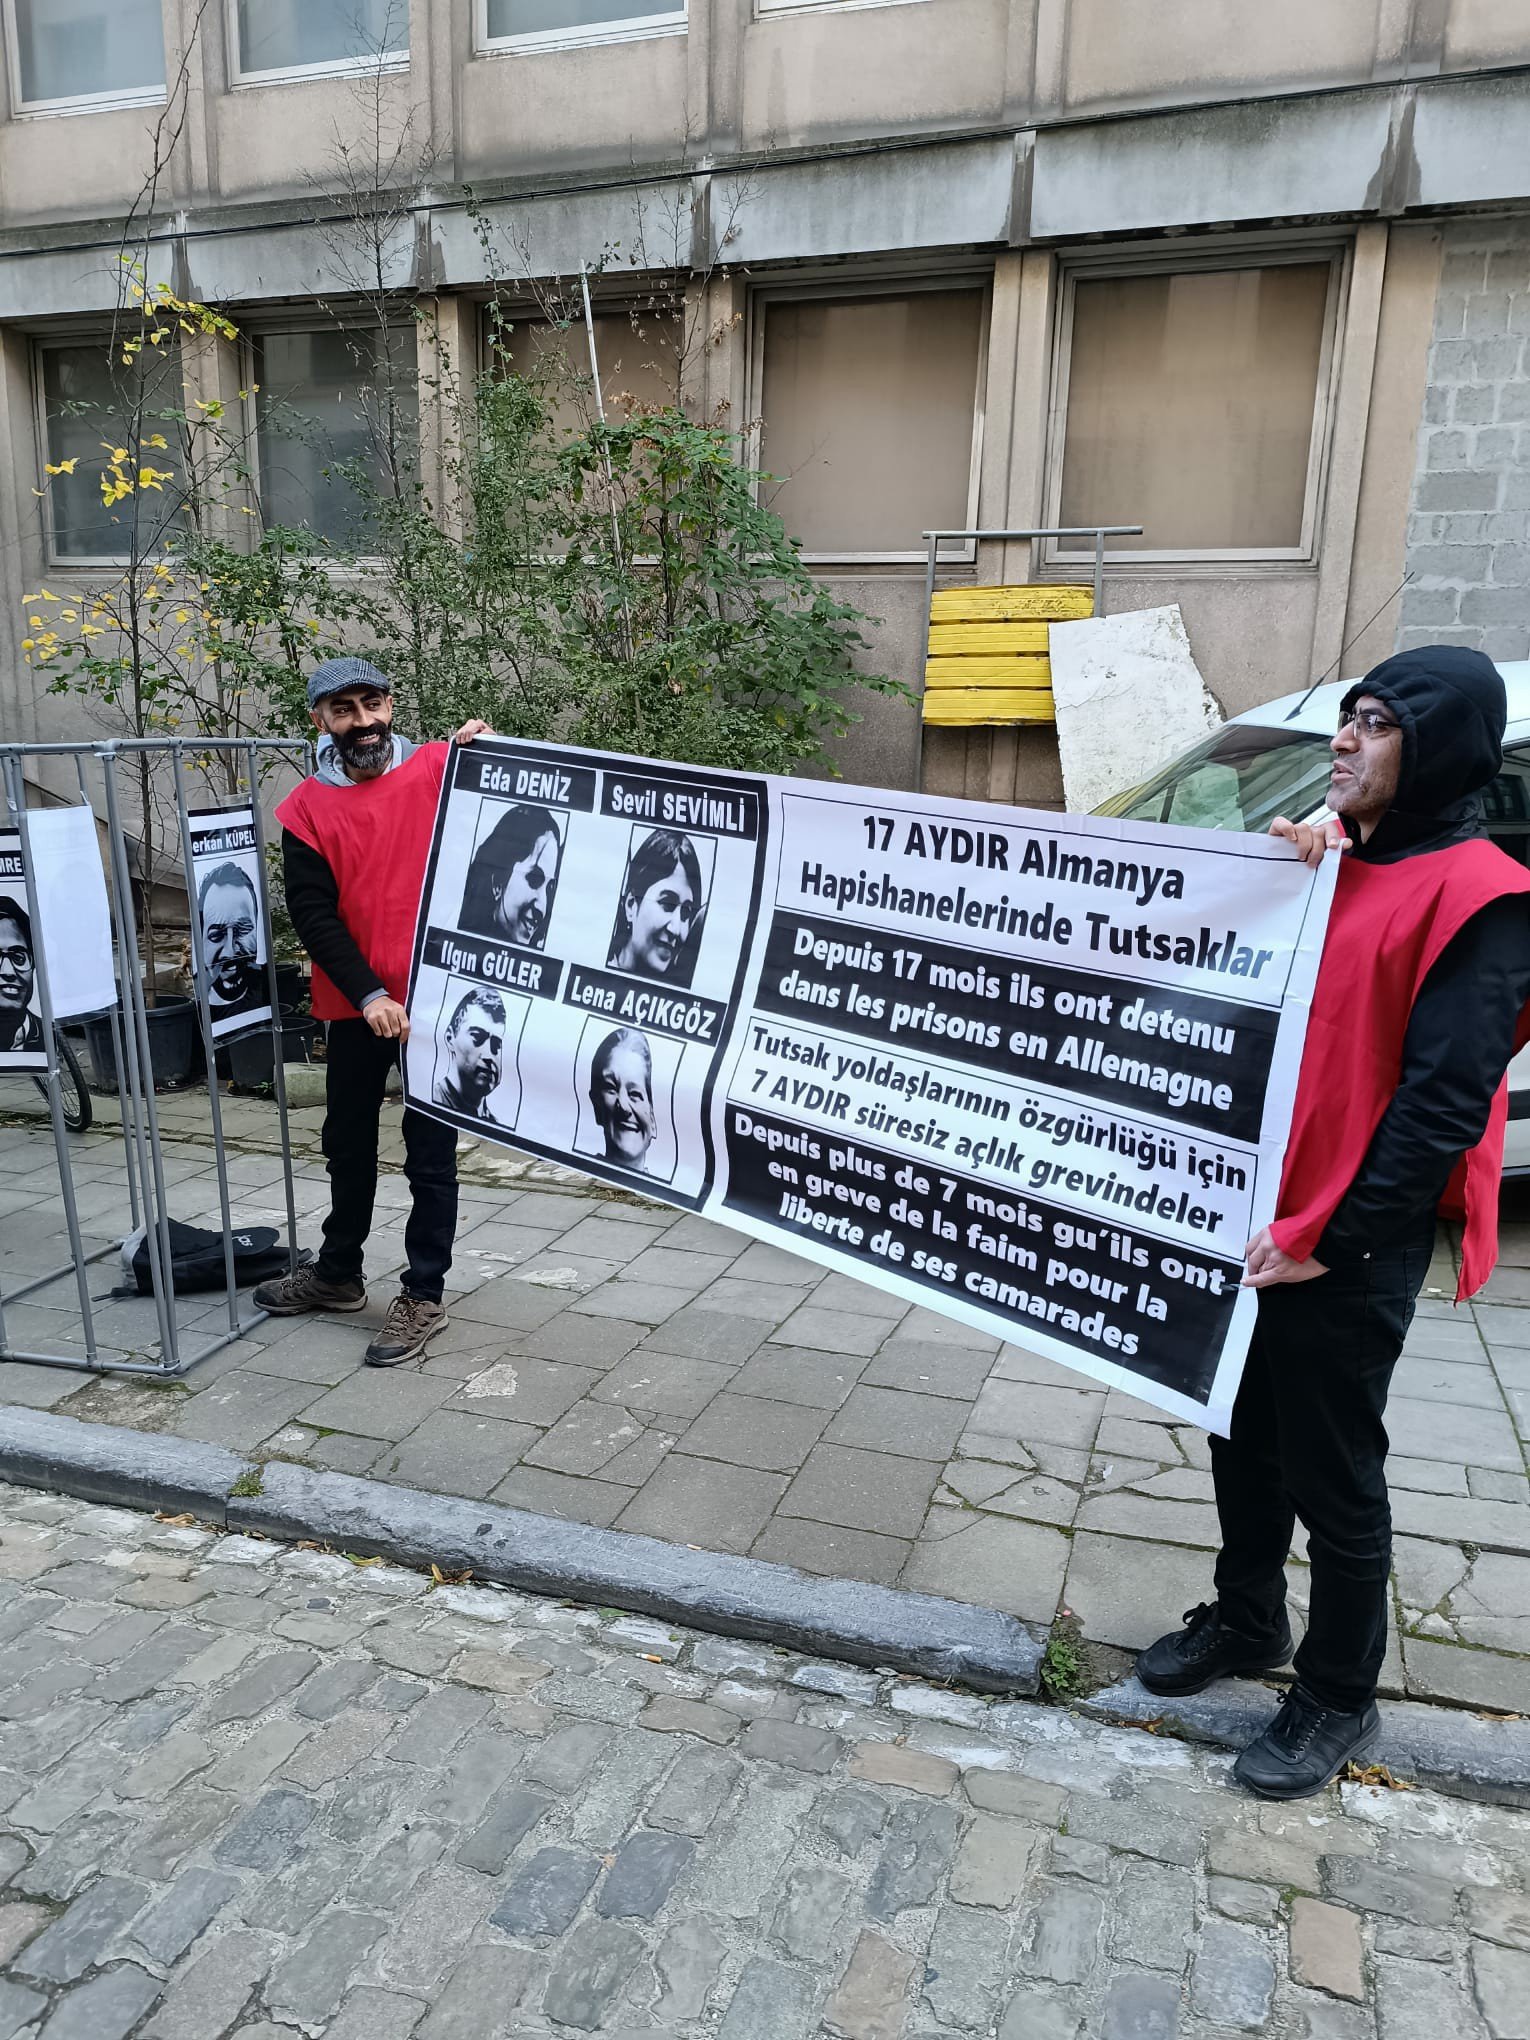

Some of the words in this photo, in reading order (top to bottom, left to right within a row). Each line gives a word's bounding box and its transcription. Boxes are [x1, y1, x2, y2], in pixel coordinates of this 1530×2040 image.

[479, 763, 510, 793] Eda
[515, 769, 572, 802] DENİZ
[612, 784, 657, 817] Sevil
[662, 791, 745, 832] SEVİMLİ
[192, 836, 223, 853] erkan
[863, 814, 896, 852] 17
[903, 822, 1008, 872] AYDIR
[1019, 838, 1185, 907] Almanya
[440, 939, 477, 973] Ilgın
[481, 950, 543, 990] GÜLER
[800, 861, 1073, 946] Hapishanelerinde
[1085, 912, 1274, 980] Tutsaklar
[570, 975, 615, 1012] Lena
[619, 990, 717, 1039] AÇIKGÖZ
[778, 969, 841, 1009] dans
[846, 983, 886, 1020] les
[889, 1001, 1002, 1049] prisons
[1008, 1030, 1049, 1061] en
[1054, 1035, 1233, 1111] Allemagne
[793, 927, 884, 973] Depuis
[892, 948, 923, 981] 17
[929, 965, 1001, 999] mois
[1009, 972, 1046, 1009] ils
[1053, 991, 1114, 1025] ont
[1119, 997, 1236, 1055] detenu
[750, 1068, 769, 1093] 7
[768, 1074, 852, 1121] AYDIR
[854, 1102, 950, 1150] süresiz
[954, 1135, 1026, 1174] açlık
[1028, 1158, 1224, 1234] grevindeler
[752, 1026, 831, 1070] Tutsak
[831, 1054, 1011, 1122] yoldaşlarının
[1018, 1098, 1177, 1171] özgürlüğü
[1187, 1145, 1246, 1191] için
[734, 1111, 822, 1160] Depuis
[828, 1146, 887, 1182] plus
[894, 1165, 931, 1195] de
[938, 1177, 959, 1204] 7
[966, 1191, 1044, 1232] mois
[1160, 1256, 1226, 1296] ont
[767, 1161, 799, 1185] en
[805, 1173, 882, 1213] greve
[888, 1197, 925, 1229] de
[931, 1209, 959, 1242] la
[966, 1223, 1038, 1272] faim
[1045, 1256, 1129, 1305] pour
[1135, 1283, 1169, 1322] la
[778, 1191, 864, 1246] liberte
[869, 1229, 906, 1262] de
[910, 1249, 959, 1282] ses
[964, 1270, 1140, 1355] camarades
